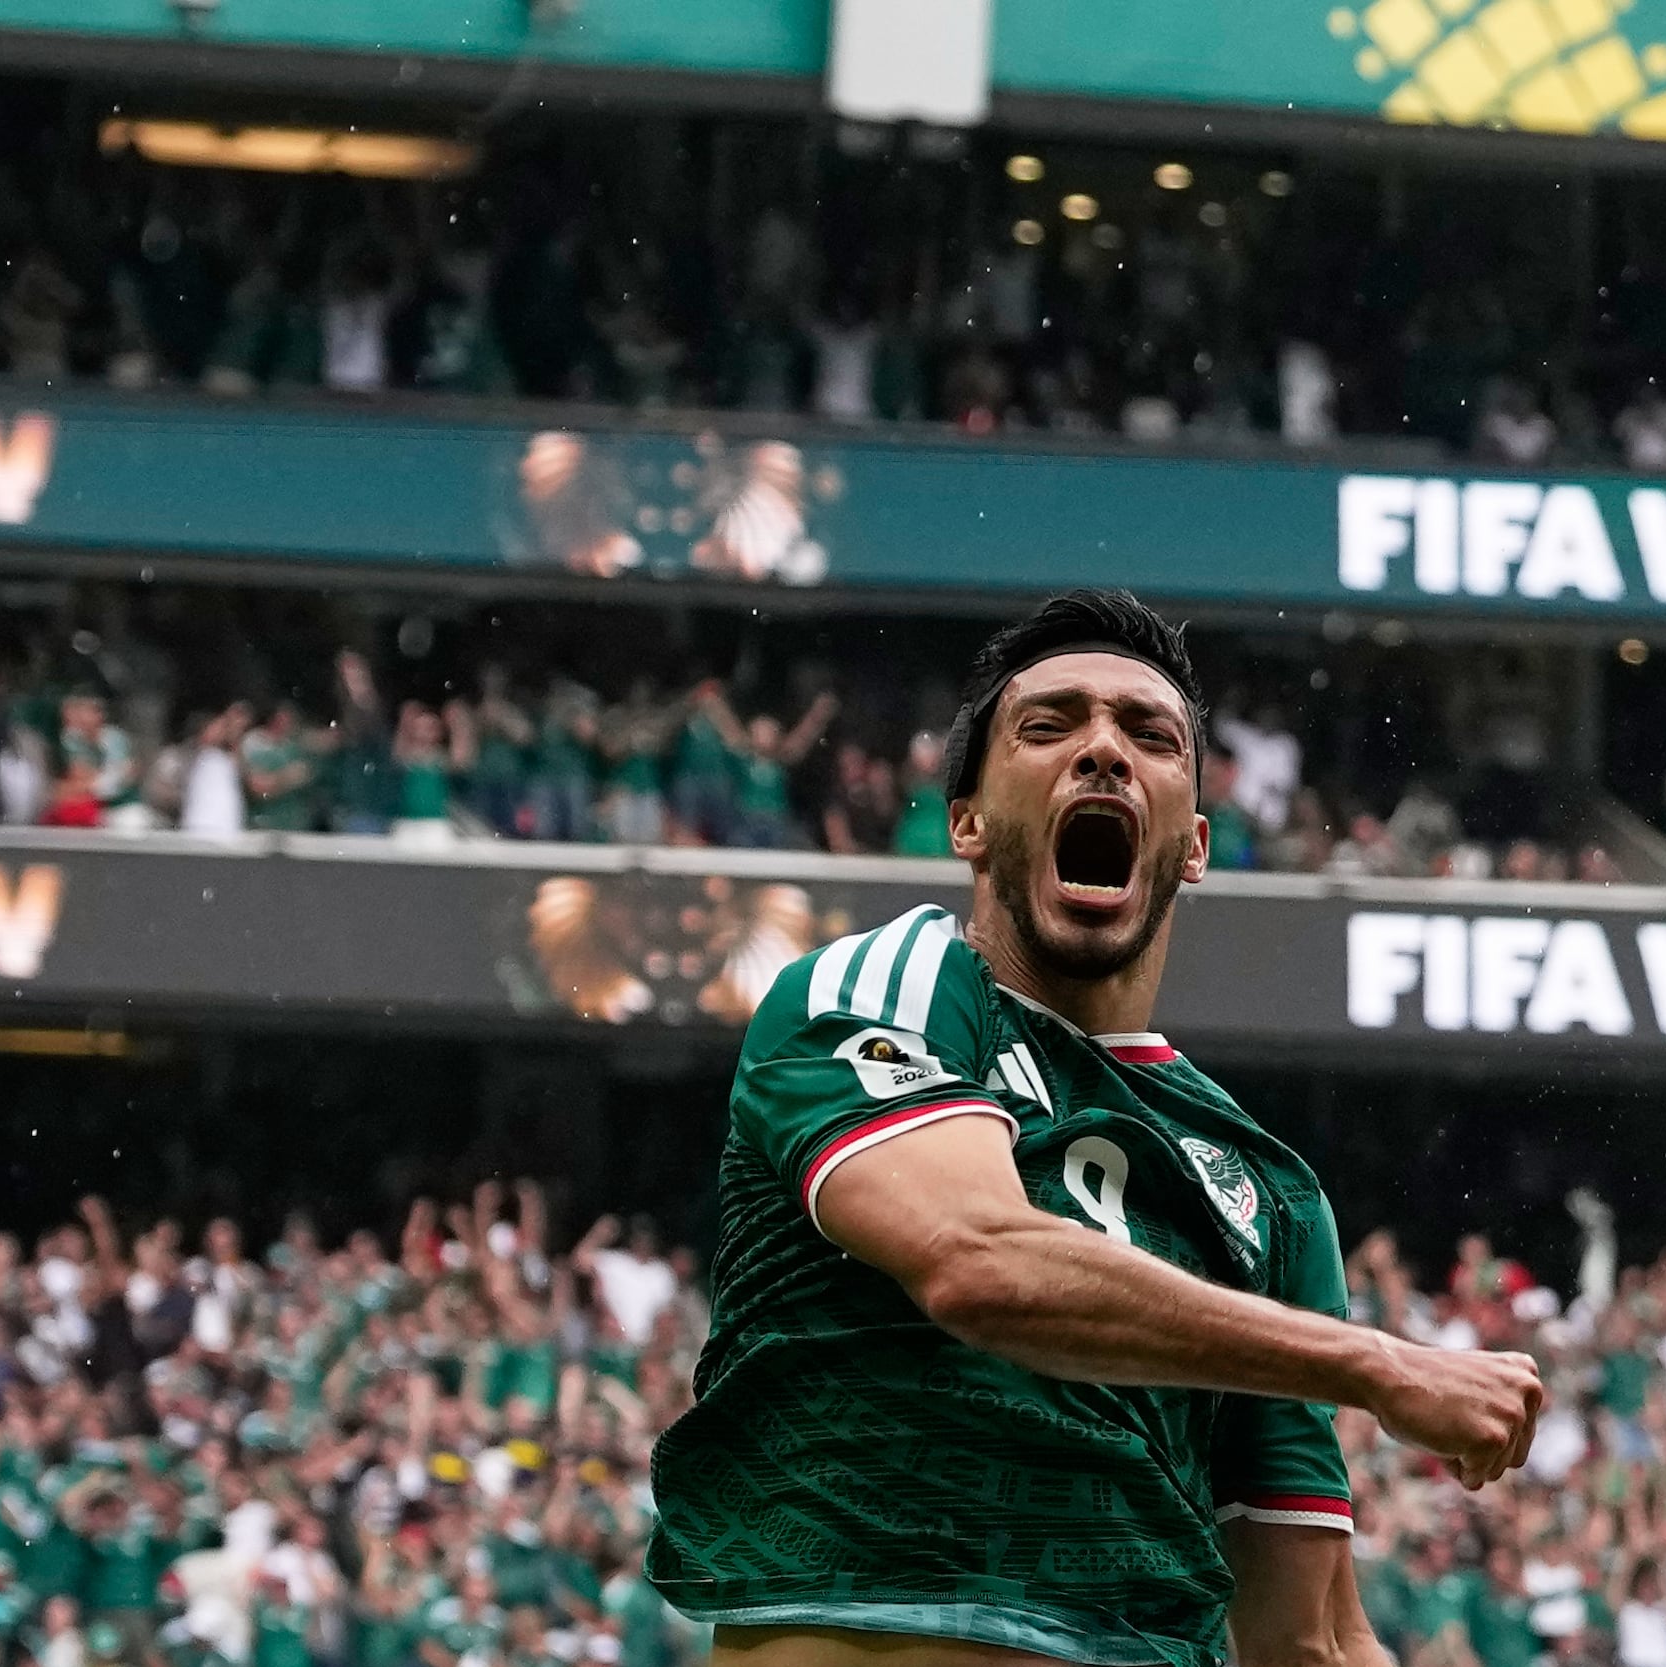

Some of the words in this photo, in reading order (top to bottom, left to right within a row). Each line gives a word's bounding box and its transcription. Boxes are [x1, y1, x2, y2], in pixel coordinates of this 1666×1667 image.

[1337, 475, 1623, 601] FIFA
[1346, 912, 1635, 1036] FIFA
[1063, 1135, 1132, 1244] 9
